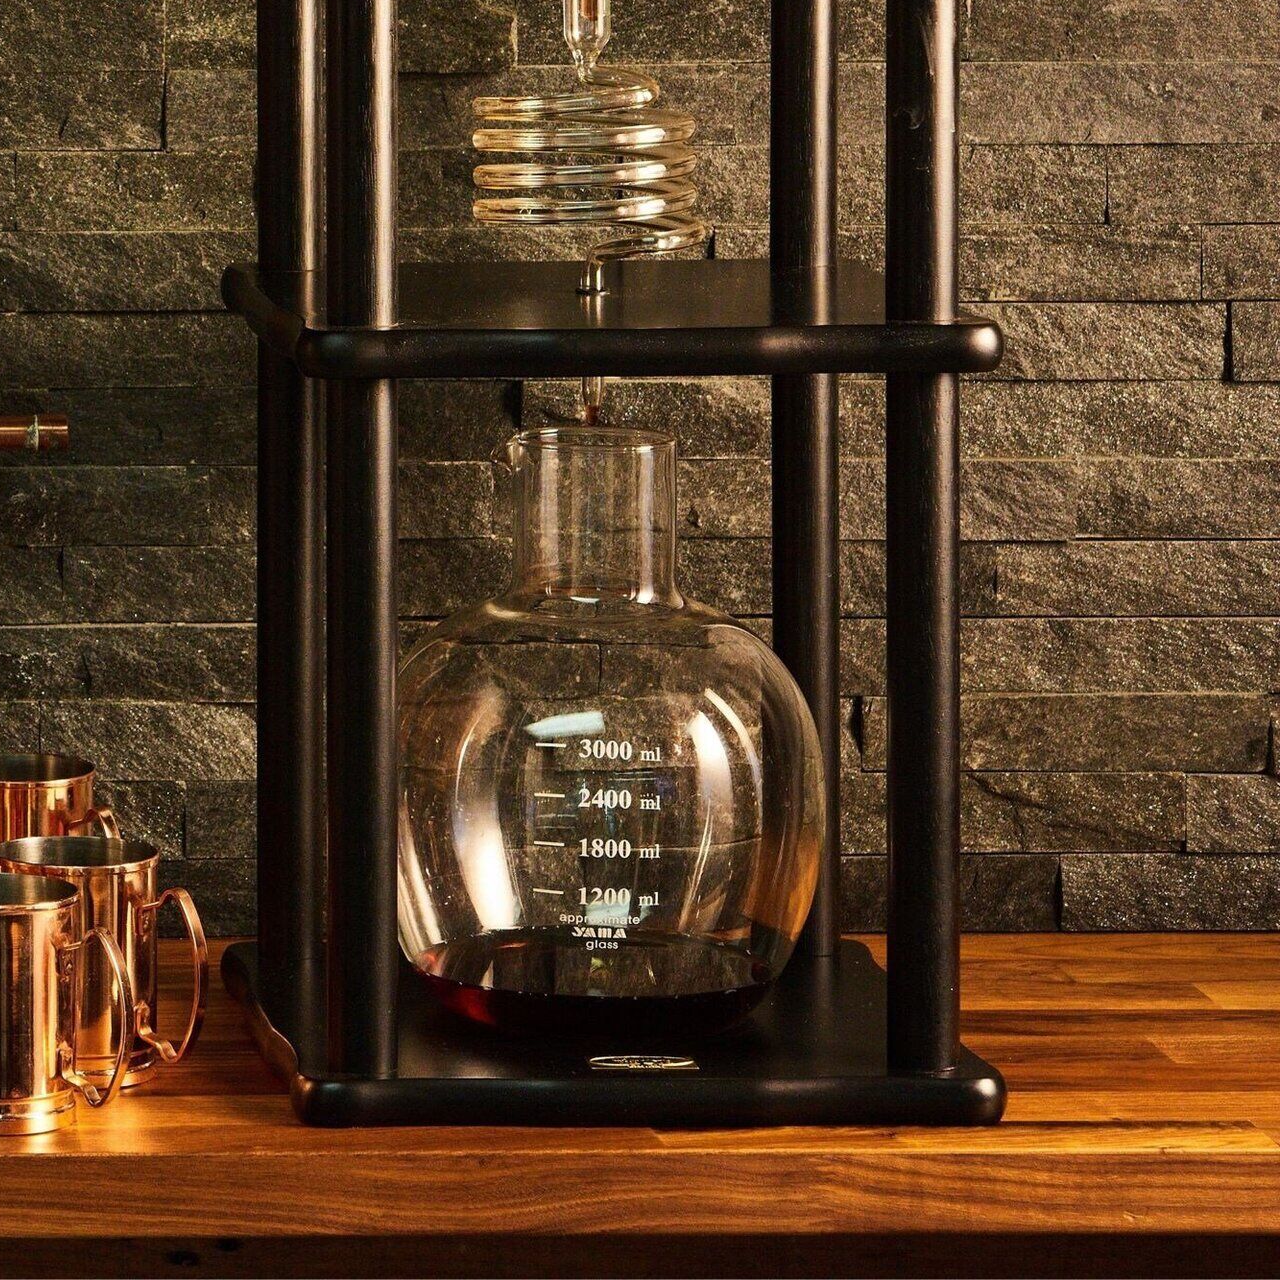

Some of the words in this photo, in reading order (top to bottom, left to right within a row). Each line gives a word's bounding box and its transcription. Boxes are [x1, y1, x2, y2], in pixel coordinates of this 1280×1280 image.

[578, 739, 632, 760] 3000
[639, 747, 662, 762] ml
[577, 788, 632, 809] 2400
[639, 795, 661, 811] ml
[578, 838, 632, 858] 1800
[639, 844, 661, 860] ml
[578, 886, 631, 906] 1200
[638, 891, 660, 907] ml
[585, 939, 619, 951] glass
